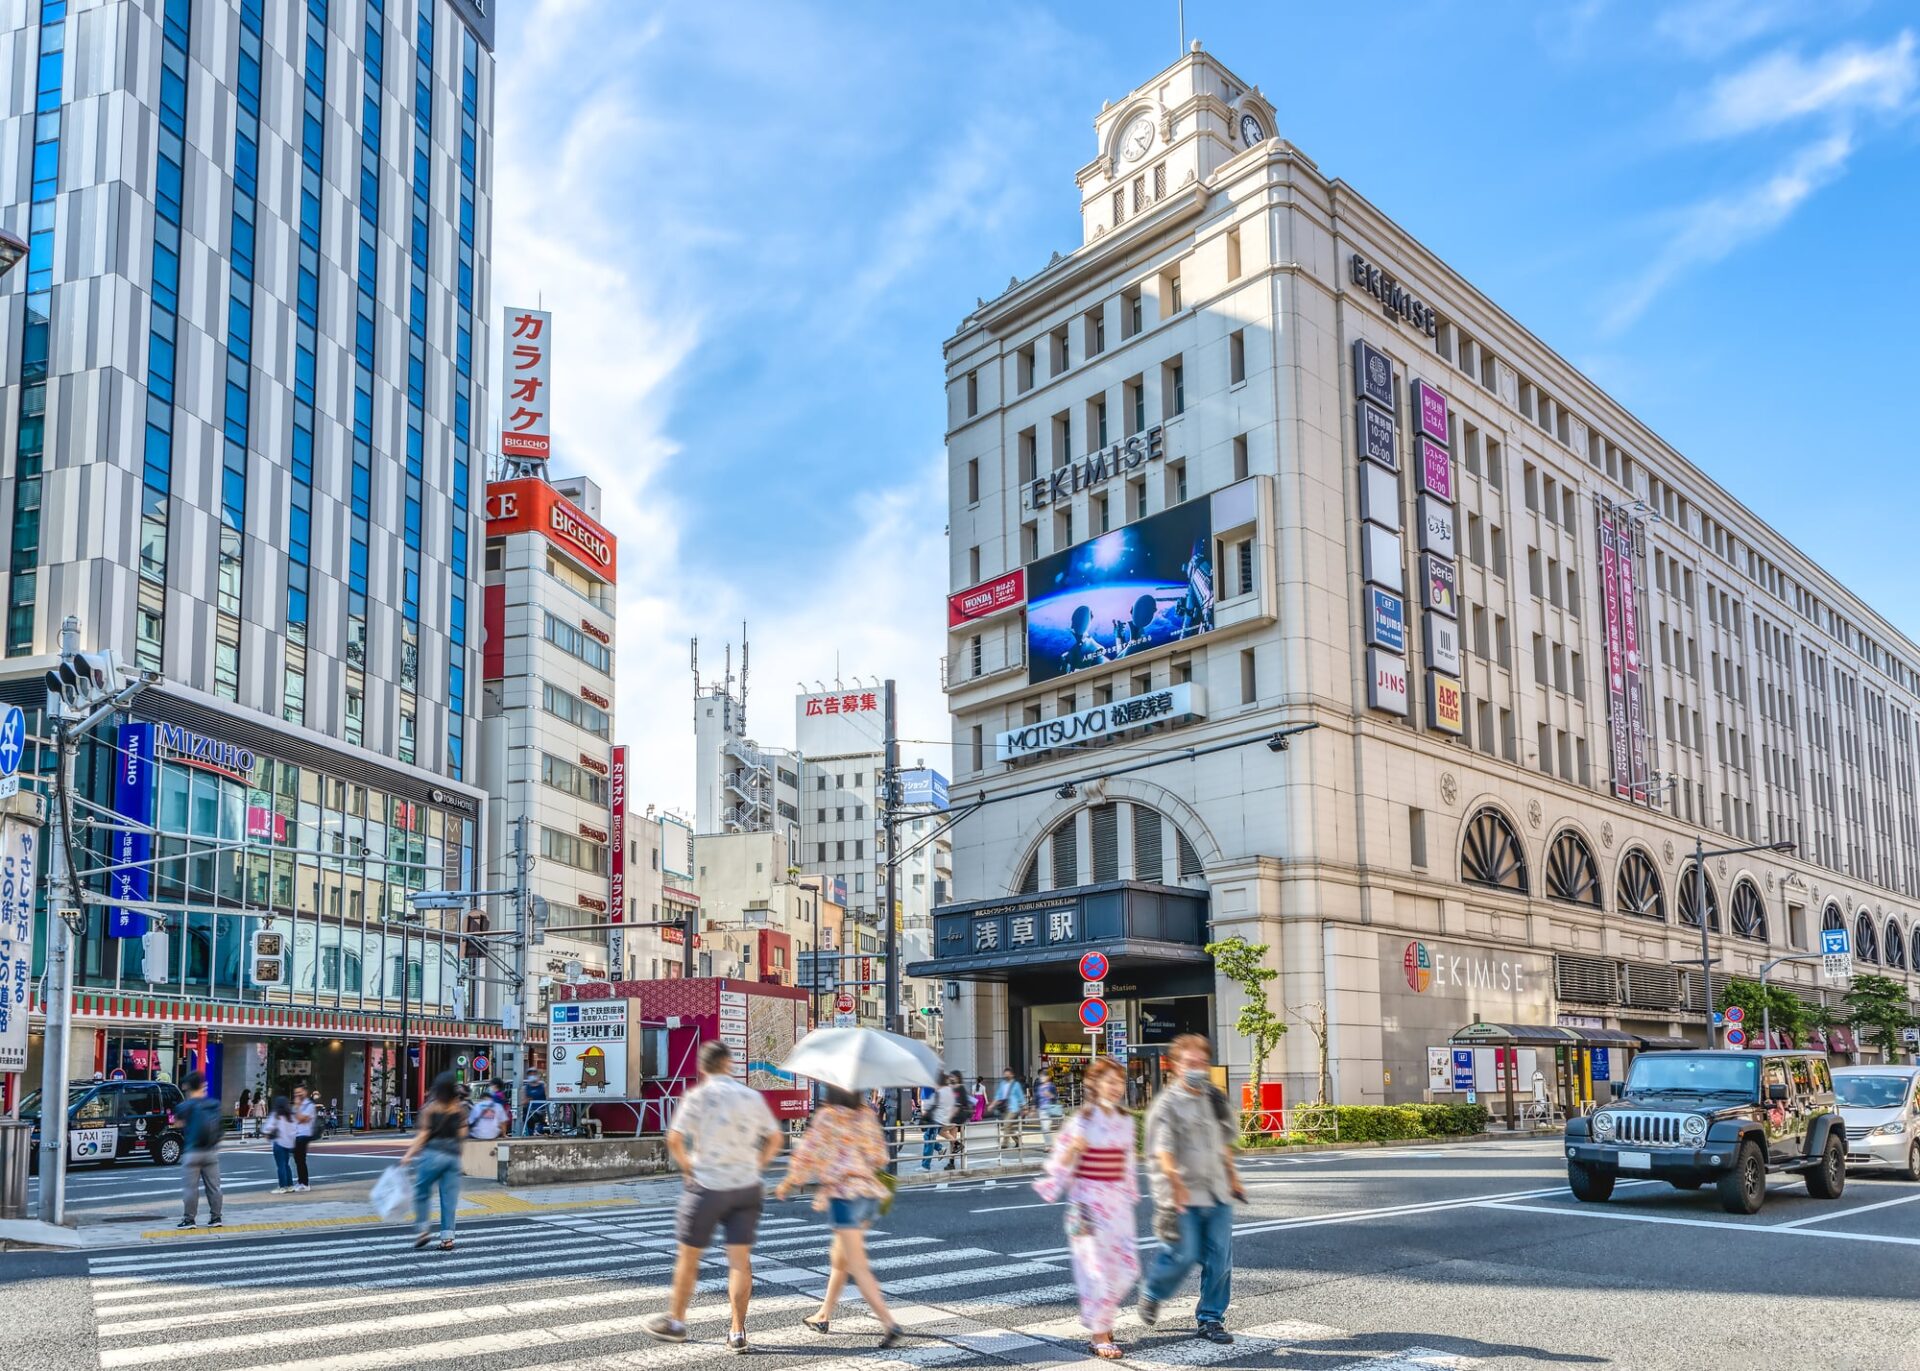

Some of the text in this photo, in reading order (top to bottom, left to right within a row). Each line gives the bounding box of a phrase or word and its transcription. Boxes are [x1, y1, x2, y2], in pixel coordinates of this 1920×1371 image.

[1353, 254, 1434, 338] EKIMISE
[510, 314, 543, 431] カラオケ
[1366, 380, 1392, 401] EKIMISE
[1371, 424, 1389, 443] 10:00
[523, 439, 548, 450] ECHO
[1371, 442, 1390, 462] 20:00
[1426, 445, 1447, 465] レストラン
[1032, 425, 1163, 510] EKIMISE
[1428, 459, 1445, 477] 11:00
[1428, 476, 1446, 494] 22:00
[552, 505, 577, 537] BIG
[578, 526, 611, 566] ECHO
[1431, 562, 1453, 583] Seria
[965, 592, 993, 609] WONDA
[806, 693, 878, 716] 広告募集
[1439, 686, 1458, 708] ABC
[1111, 692, 1173, 727] 松屋浅草
[1439, 703, 1459, 722] MART
[161, 722, 255, 772] MIZUHO
[1619, 702, 1627, 778] RESTAURANT
[127, 735, 139, 785] MIZUHO
[613, 763, 624, 806] カラオケ
[442, 794, 473, 810] TOBU HOTEL
[612, 873, 623, 917] カラオケ
[1018, 902, 1035, 911] TOBU
[1036, 899, 1064, 909] SKYTREE
[1064, 897, 1077, 905] Line
[15, 834, 32, 1003] やさしさが 走る
[975, 911, 1074, 950] 浅草駅
[0, 857, 14, 1032] この街 この道路
[1436, 954, 1524, 992] EKIMISE
[1112, 984, 1137, 992] Station
[582, 1006, 624, 1015] 地下鉄銀座線
[77, 1132, 98, 1141] TAXI
[77, 1142, 98, 1156] GO
